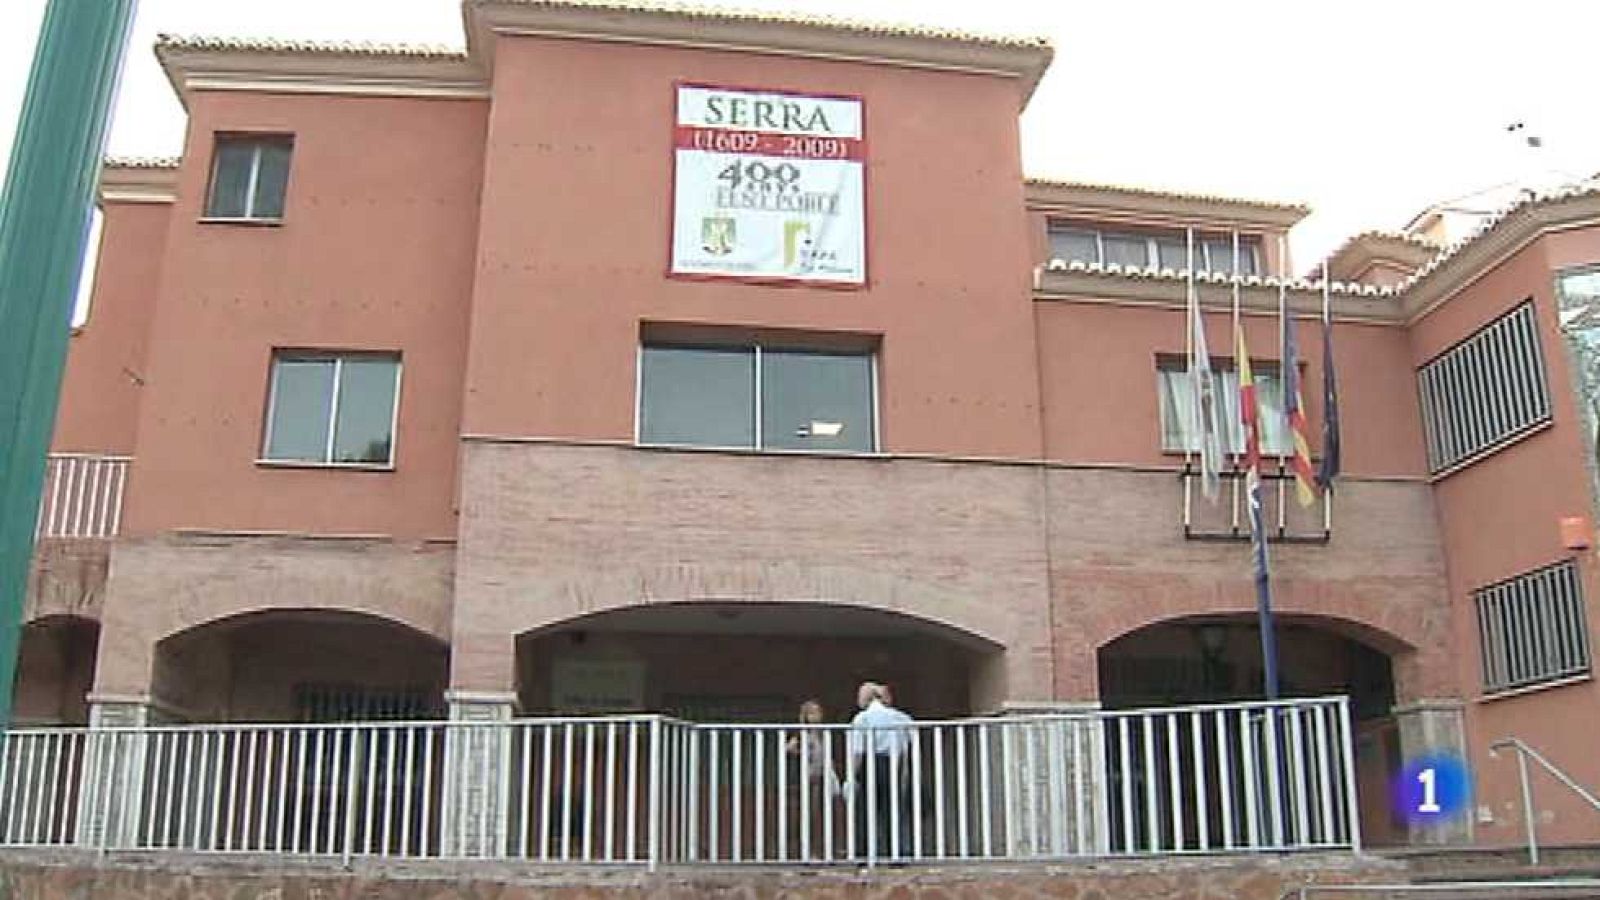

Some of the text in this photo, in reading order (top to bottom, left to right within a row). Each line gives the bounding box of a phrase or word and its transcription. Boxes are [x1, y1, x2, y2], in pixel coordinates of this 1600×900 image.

[704, 95, 832, 132] SERRA
[693, 130, 759, 151] (1609
[783, 136, 848, 158] 2009)
[717, 159, 800, 189] 400
